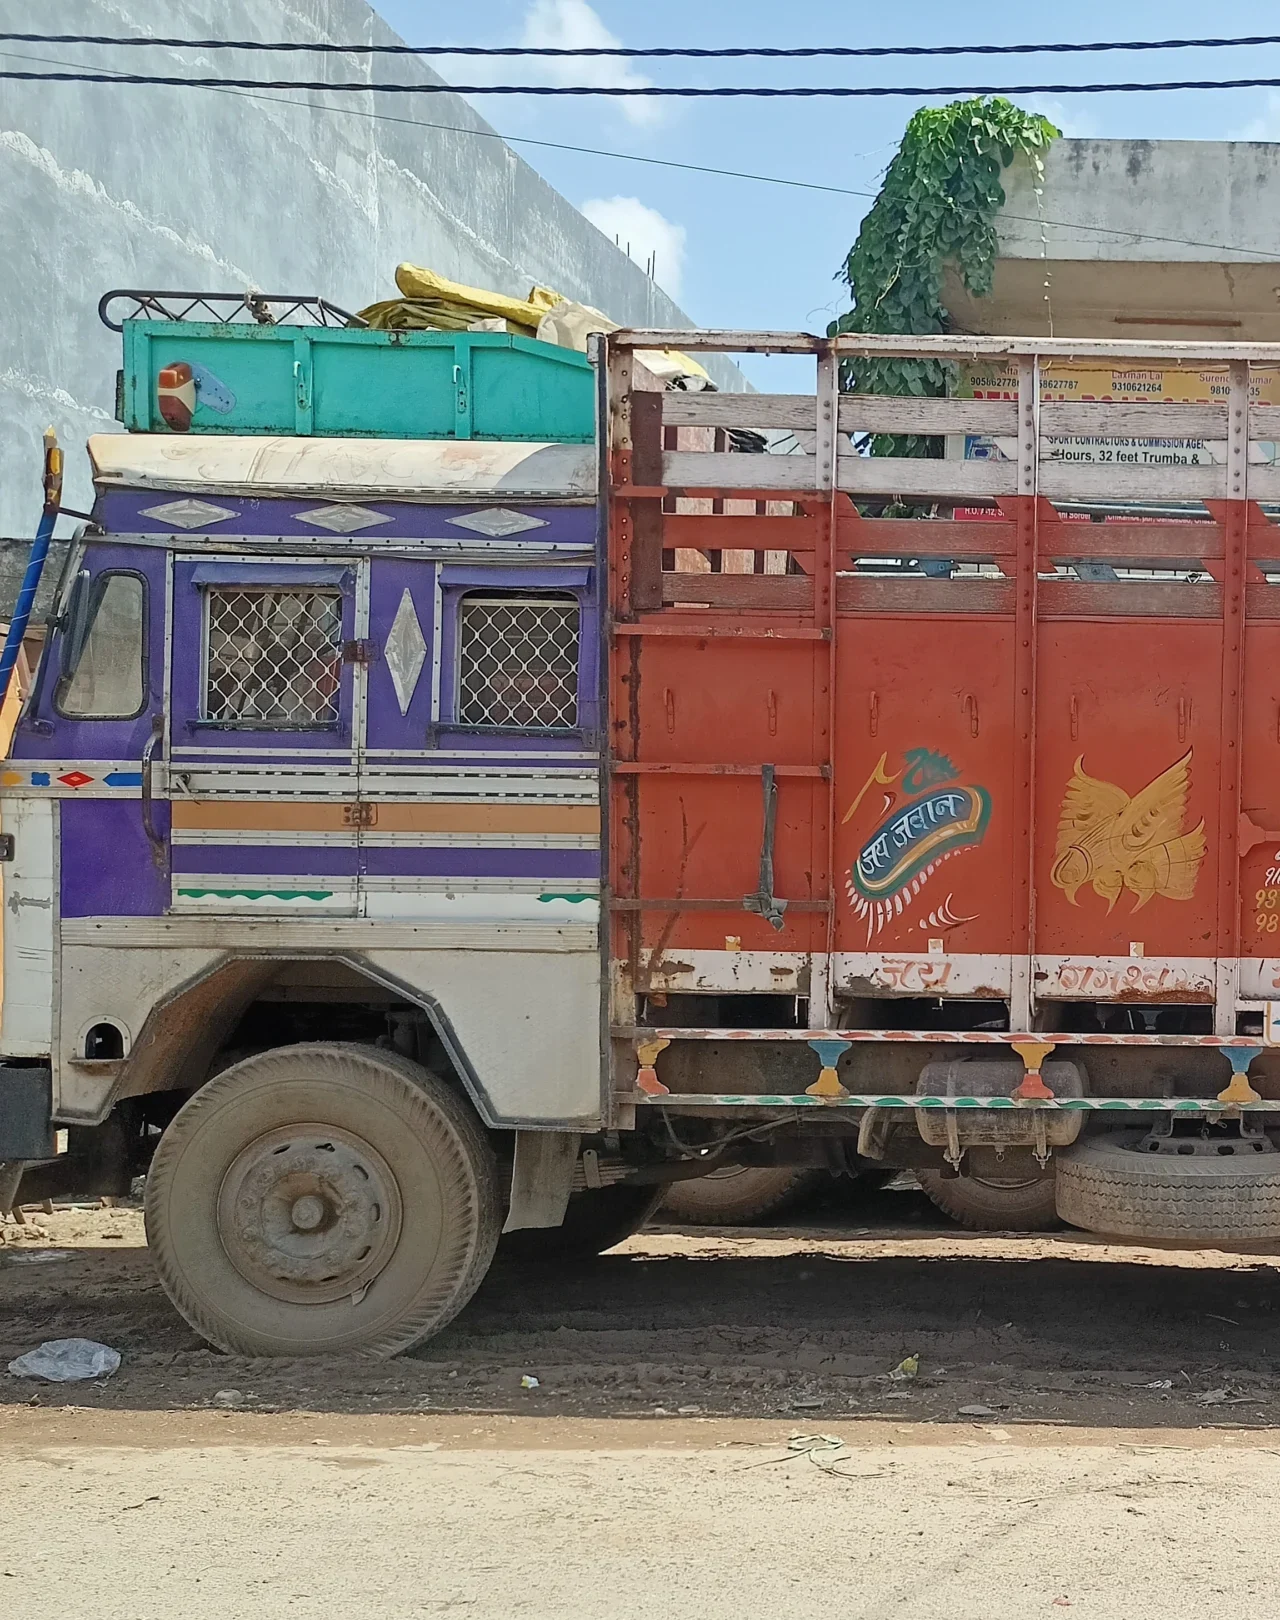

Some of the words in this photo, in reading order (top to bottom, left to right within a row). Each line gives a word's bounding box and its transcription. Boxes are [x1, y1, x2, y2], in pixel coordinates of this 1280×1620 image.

[1112, 382, 1162, 392] 9310621264
[1249, 377, 1273, 385] umar
[1098, 450, 1113, 462] 32
[1116, 450, 1138, 463] feet
[1142, 452, 1187, 465] Trumba
[1191, 454, 1200, 465] &
[860, 833, 891, 875] जय
[891, 794, 965, 848] जवान
